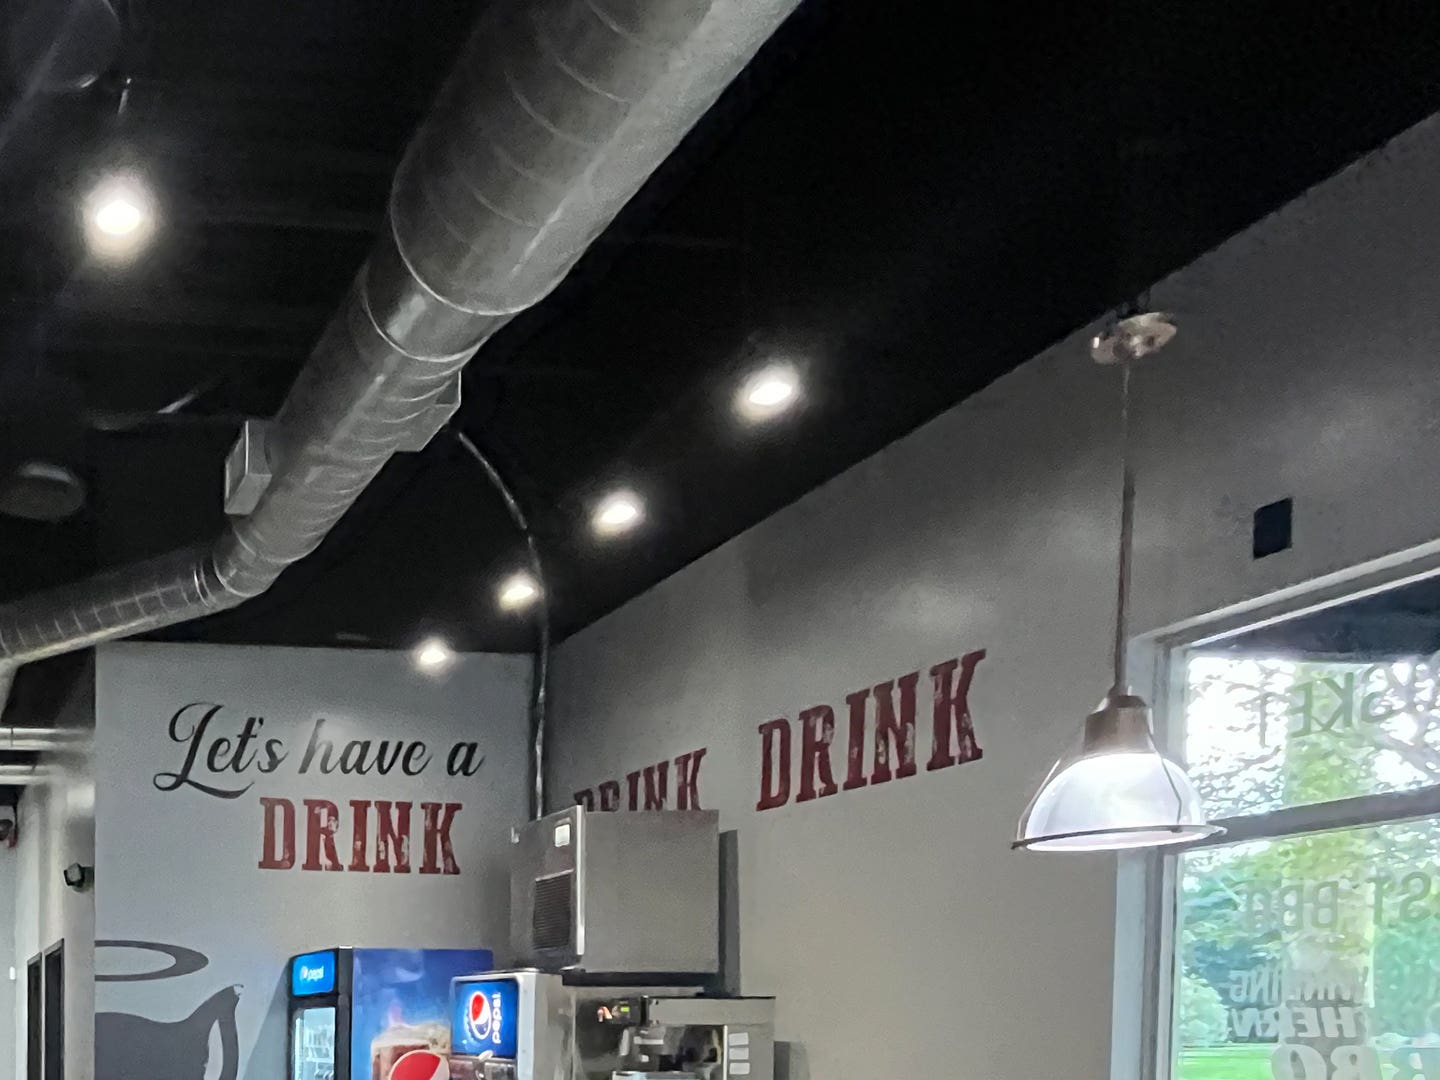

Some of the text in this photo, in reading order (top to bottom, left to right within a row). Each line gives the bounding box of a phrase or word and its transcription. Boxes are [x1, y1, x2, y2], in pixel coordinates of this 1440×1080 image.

[152, 701, 486, 799] Let's have a
[755, 647, 988, 812] DRINK
[257, 796, 463, 876] DRINK
[491, 992, 503, 1045] pepsi
